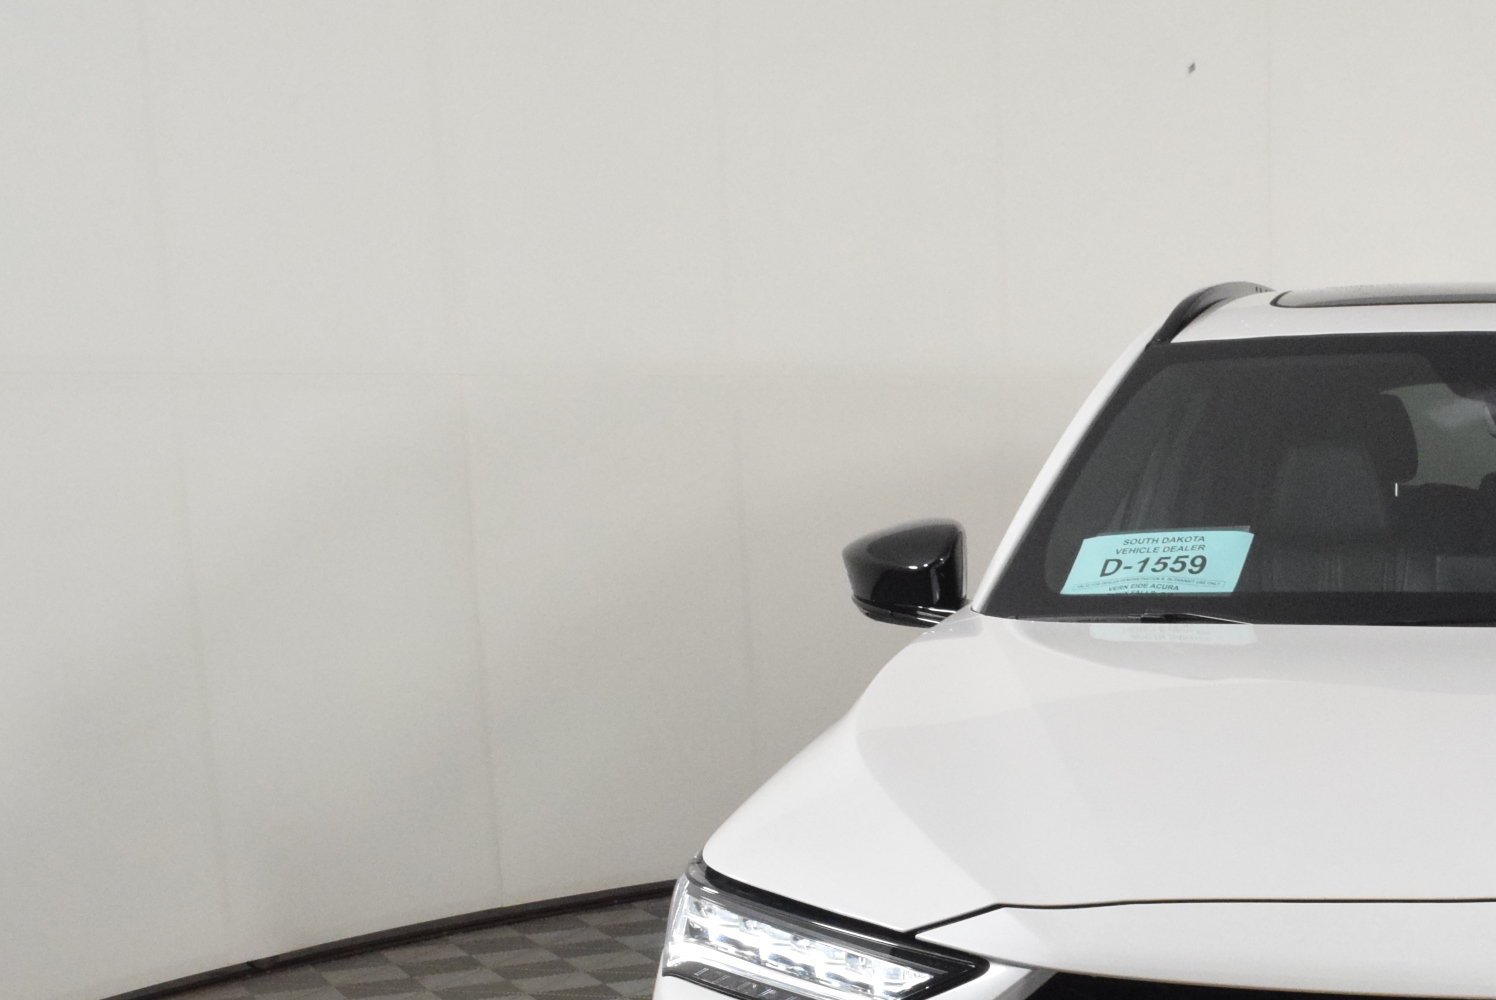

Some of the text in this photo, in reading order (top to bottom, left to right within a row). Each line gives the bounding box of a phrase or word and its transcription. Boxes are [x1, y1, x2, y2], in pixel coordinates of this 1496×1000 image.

[1123, 536, 1205, 545] SOUTH DAKOTA
[1116, 545, 1206, 555] VEHICLE DEALER
[1100, 555, 1207, 577] D-1559
[1150, 583, 1179, 591] ACURA
